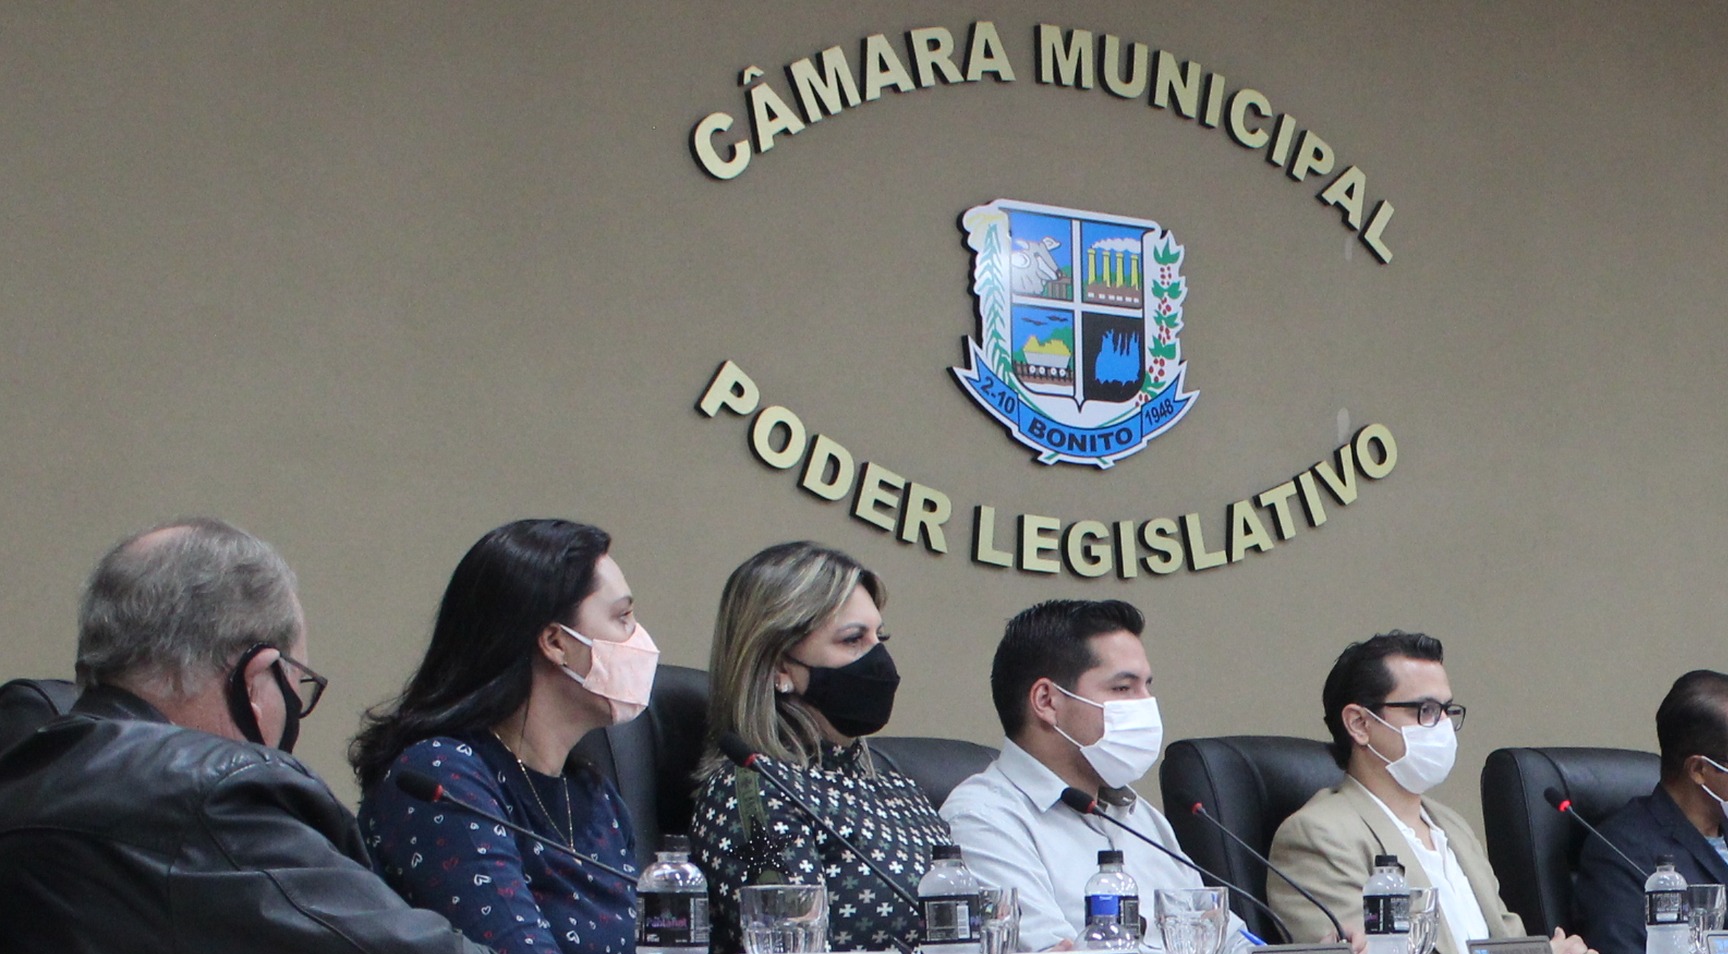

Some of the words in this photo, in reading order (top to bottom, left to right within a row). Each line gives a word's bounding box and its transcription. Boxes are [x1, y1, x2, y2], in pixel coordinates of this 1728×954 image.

[691, 20, 1015, 181] CÂMARA
[1034, 23, 1394, 264] MUNICIPAL
[695, 360, 952, 555] PODER
[972, 421, 1399, 579] LEGISLATIVO
[980, 376, 1016, 415] 2-10
[1027, 417, 1133, 453] BONITO
[1145, 399, 1175, 426] 1948
